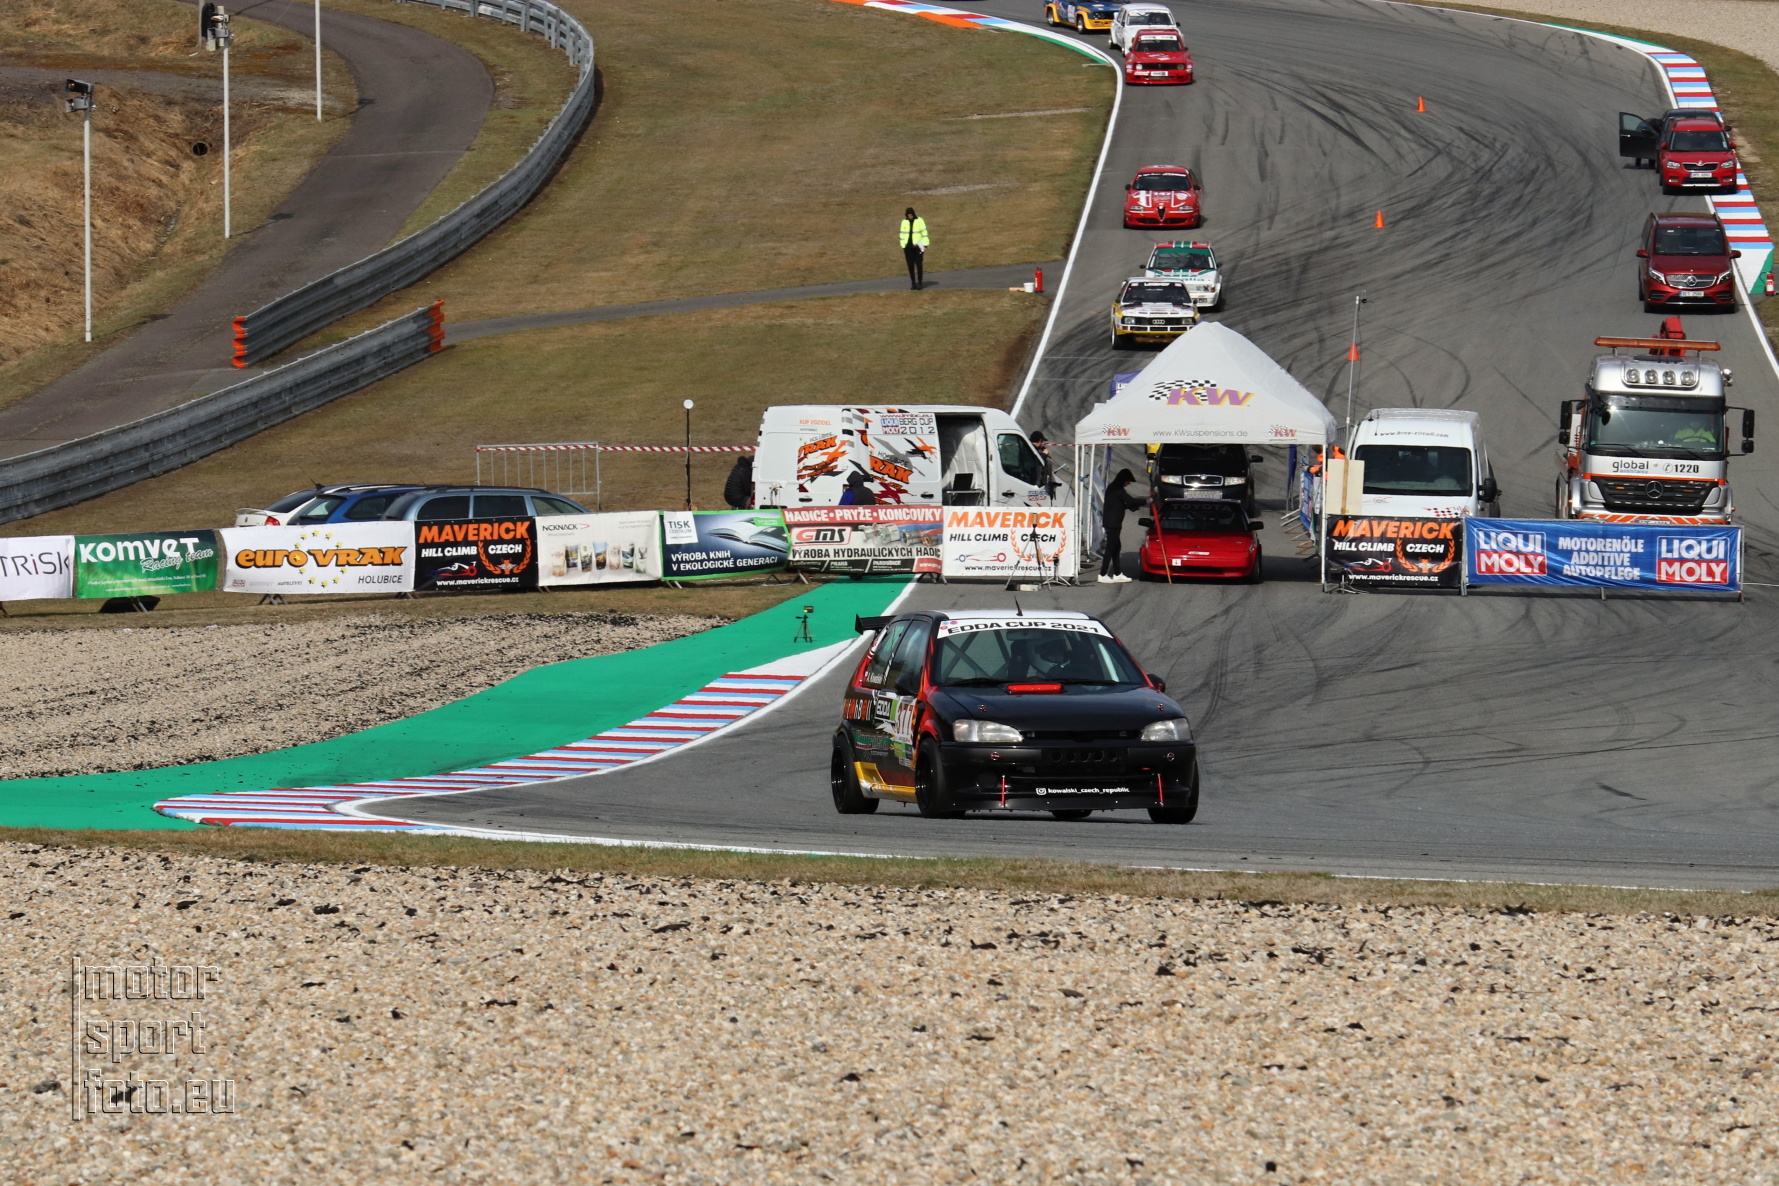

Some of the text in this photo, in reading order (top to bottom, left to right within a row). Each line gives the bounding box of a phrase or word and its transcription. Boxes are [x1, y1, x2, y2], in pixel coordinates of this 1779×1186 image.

[1166, 388, 1255, 406] KW
[900, 418, 934, 426] BERG CUP
[882, 426, 900, 434] MOLY
[1106, 428, 1130, 437] KW
[1152, 430, 1248, 438] www.KWsuspensions.de
[1274, 428, 1297, 437] KW
[1612, 460, 1699, 474] global 1220
[1173, 503, 1231, 511] TOYOTA
[785, 507, 942, 522] HADICE PRYŽE KONCOVKY
[947, 511, 1068, 529] MAVERICK
[668, 521, 690, 530] TISK
[1332, 520, 1457, 539] MAVERICK
[418, 521, 531, 544] MAVERICK
[949, 534, 972, 542] HILL
[974, 534, 1009, 542] CLIMB
[1334, 542, 1445, 554] HILL CLIMB CZECH
[1478, 531, 1542, 553] LIQUI
[1558, 536, 1644, 553] MOTORENÖLE
[421, 544, 522, 558] HILL CLIMB CZECH
[671, 550, 731, 562] VÝROBA KNIH
[792, 548, 830, 559] VÝROBA
[834, 546, 913, 558] HYDRAULICKÝCH
[1661, 539, 1725, 560] LIQUI
[140, 548, 214, 574] Racing team
[680, 558, 734, 571] EKOLOGICKÉ
[1480, 553, 1544, 574] MOLY
[1571, 552, 1630, 566] ADDITIVE
[1348, 574, 1439, 582] www.maverickrescue.cz
[1563, 565, 1640, 580] AUTOPFLEGE
[1660, 562, 1727, 582] MOLY
[358, 575, 403, 584] HOLUBICE
[436, 577, 520, 586] www.maverickrescue.cz
[948, 622, 1002, 634] EDDA
[1050, 622, 1100, 634] 2021
